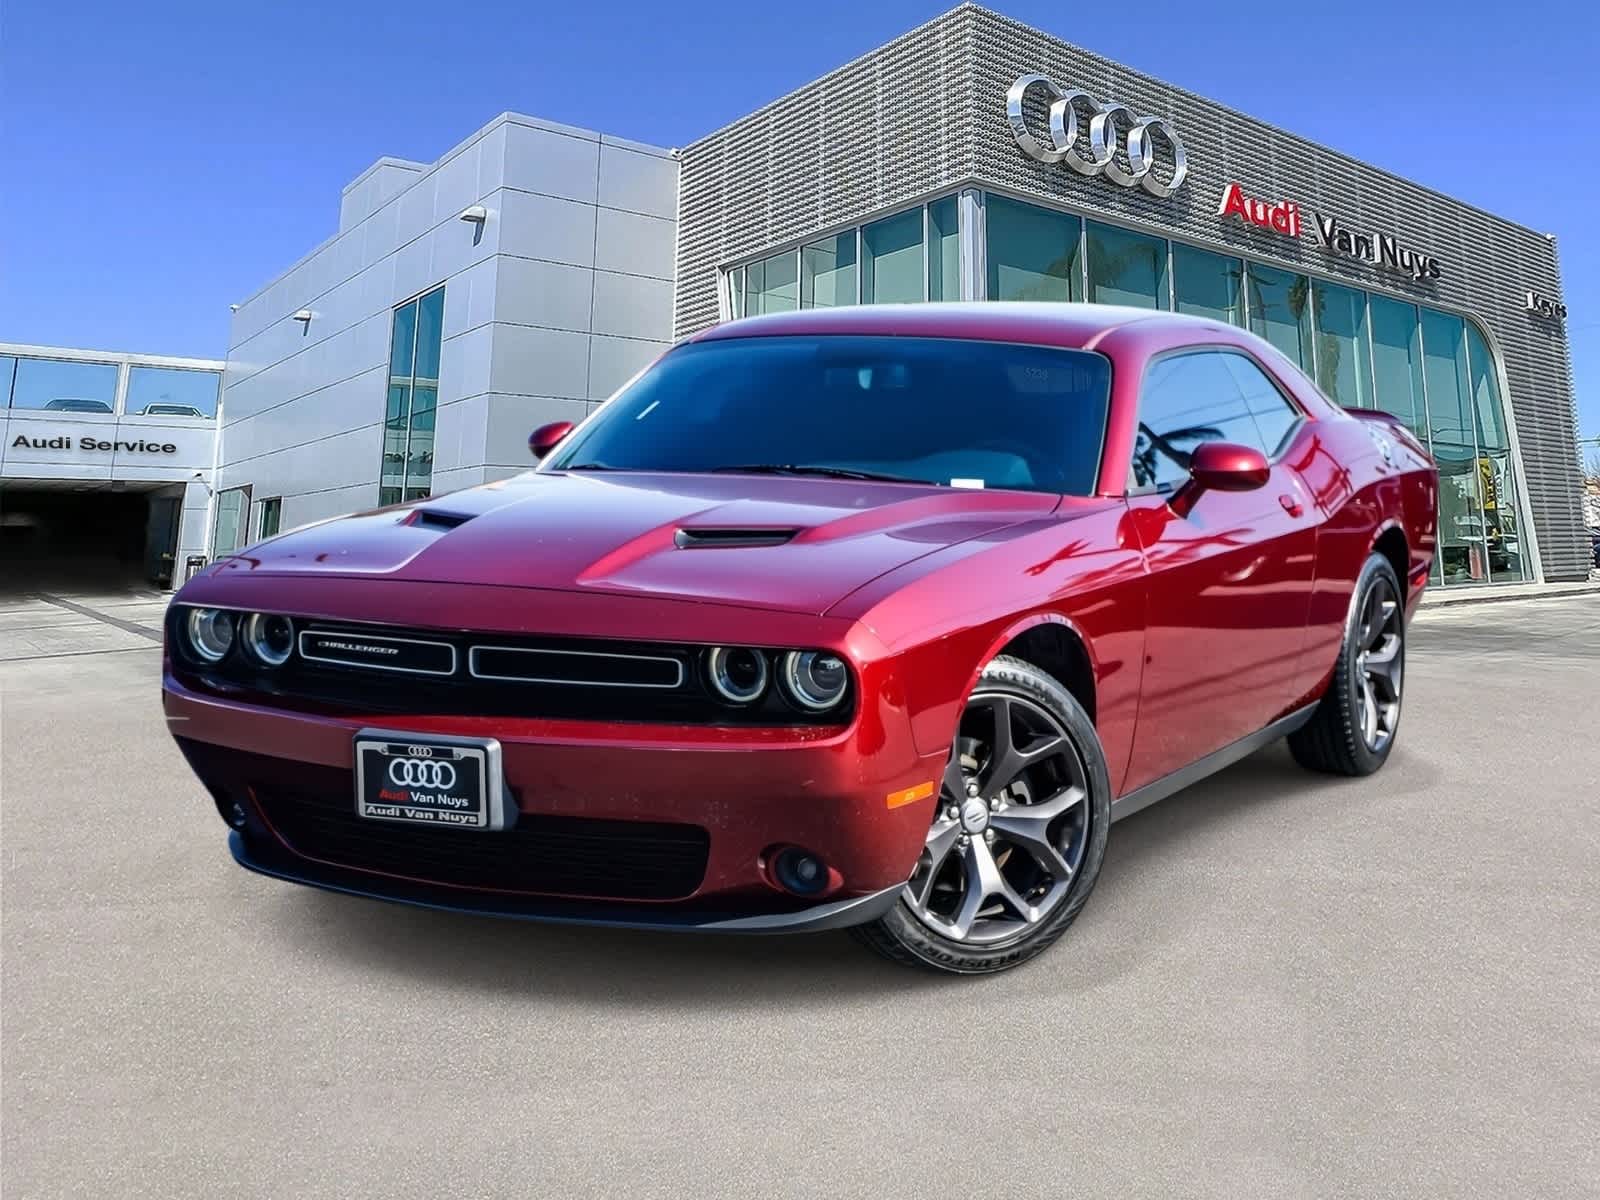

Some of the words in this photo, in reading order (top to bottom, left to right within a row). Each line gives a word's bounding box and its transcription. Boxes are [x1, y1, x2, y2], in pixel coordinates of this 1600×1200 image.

[1218, 182, 1301, 237] Audi
[1312, 212, 1373, 258] Van
[1375, 232, 1441, 280] Nuys
[1527, 291, 1567, 319] Keyes
[12, 435, 71, 449] Audi
[79, 437, 177, 453] Service
[317, 641, 399, 655] CHALLENGER
[379, 789, 409, 801] Audi
[410, 791, 434, 803] Van
[437, 794, 469, 808] Nuys
[366, 806, 400, 817] Audi
[404, 808, 434, 820] Van
[438, 812, 477, 824] Nuys
